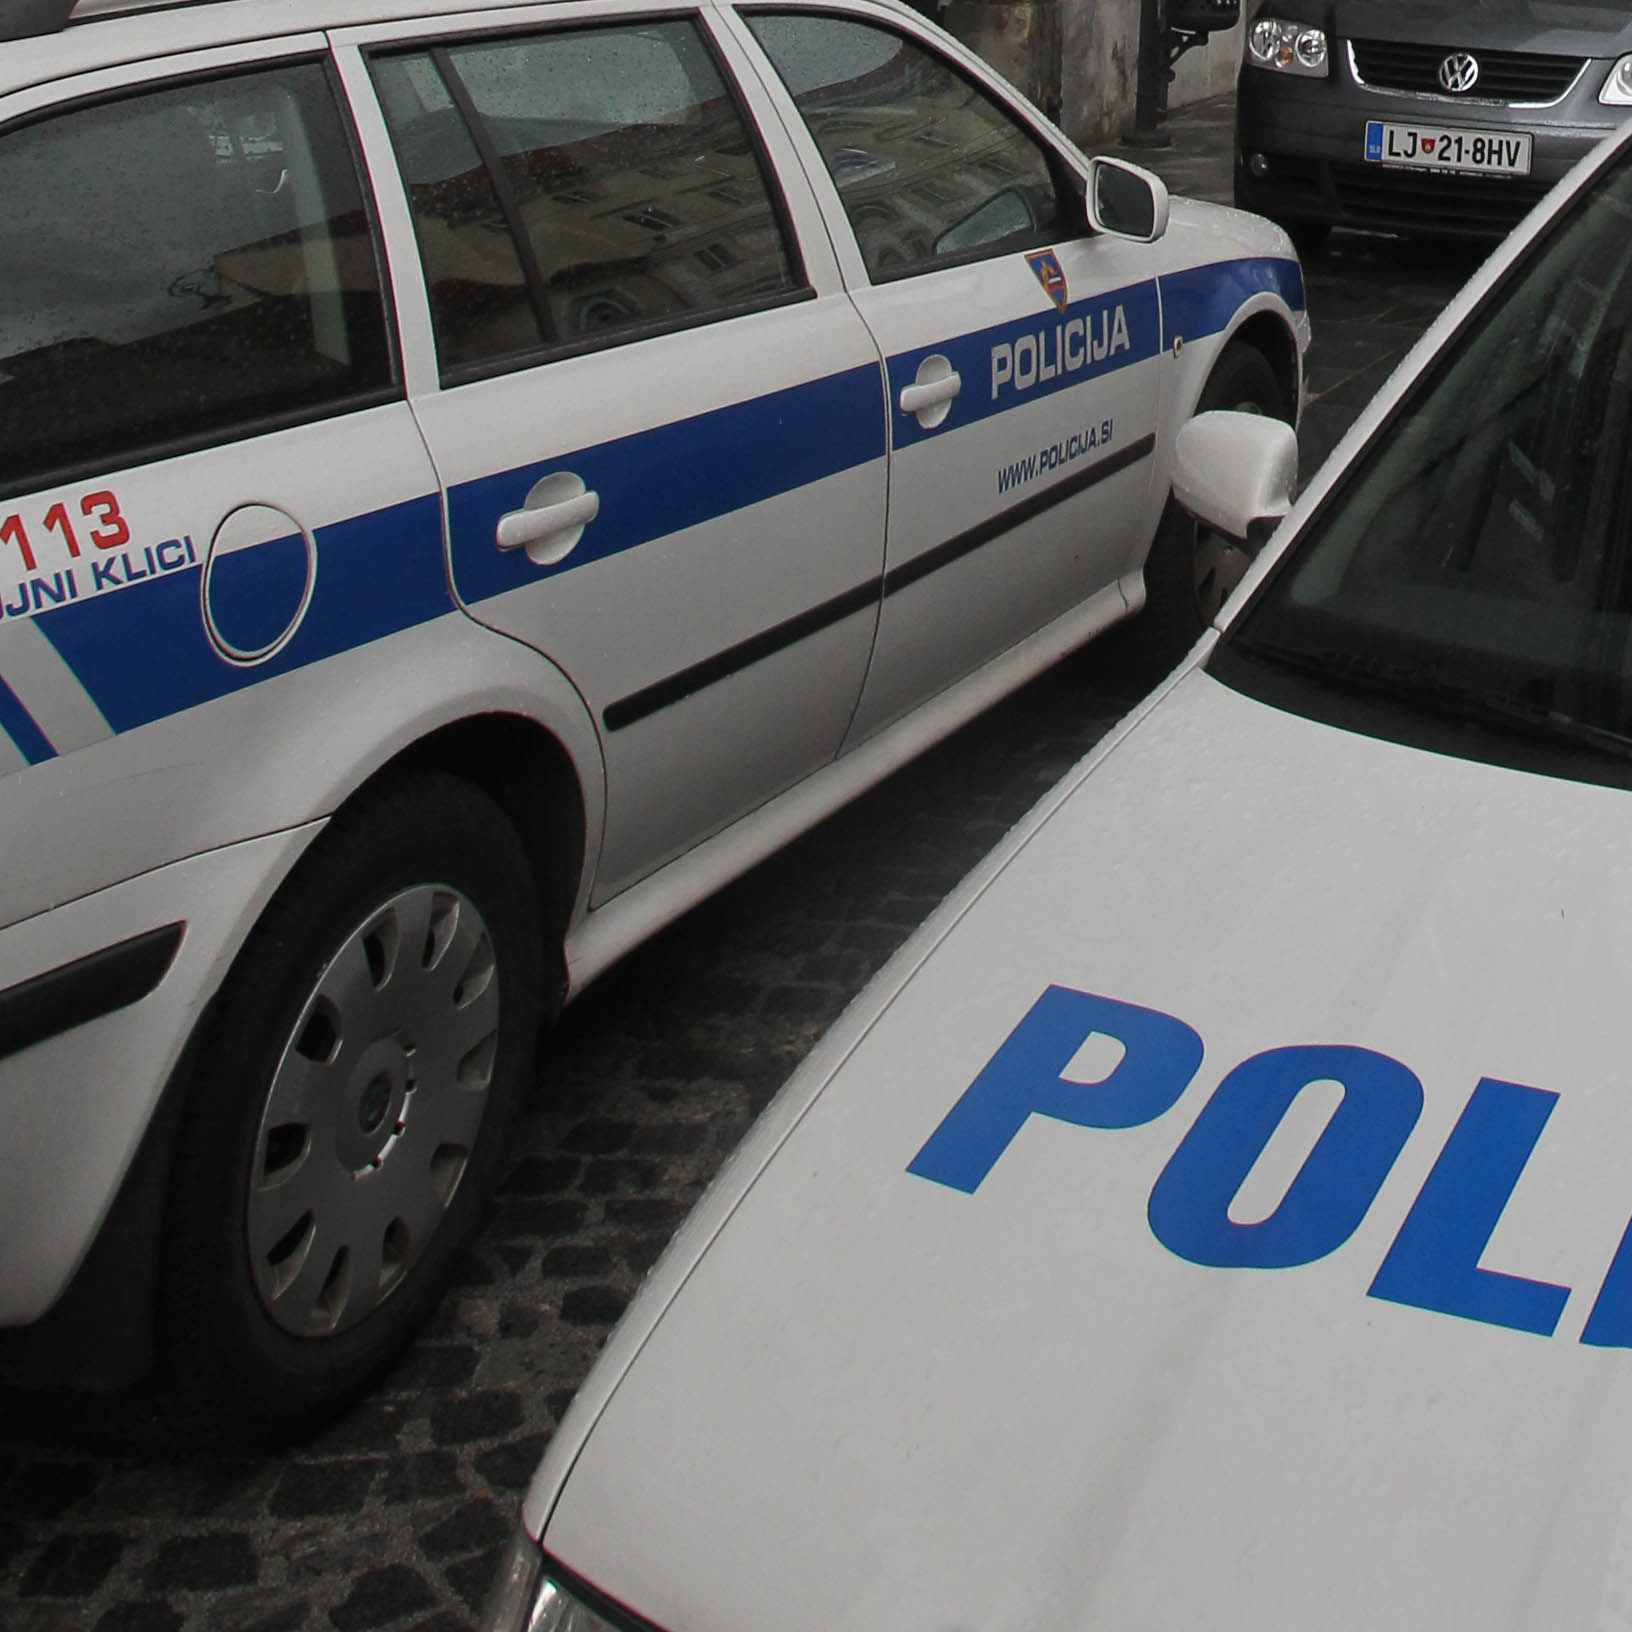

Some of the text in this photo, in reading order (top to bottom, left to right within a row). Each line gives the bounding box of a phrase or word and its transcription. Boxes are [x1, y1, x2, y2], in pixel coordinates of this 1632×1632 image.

[1387, 129, 1521, 168] LJ 21-8HV
[991, 304, 1131, 400] POLICIJA
[998, 418, 1114, 494] WWW.POLICIJA.SI
[0, 490, 130, 571] 113
[0, 535, 197, 620] JNI KLICI
